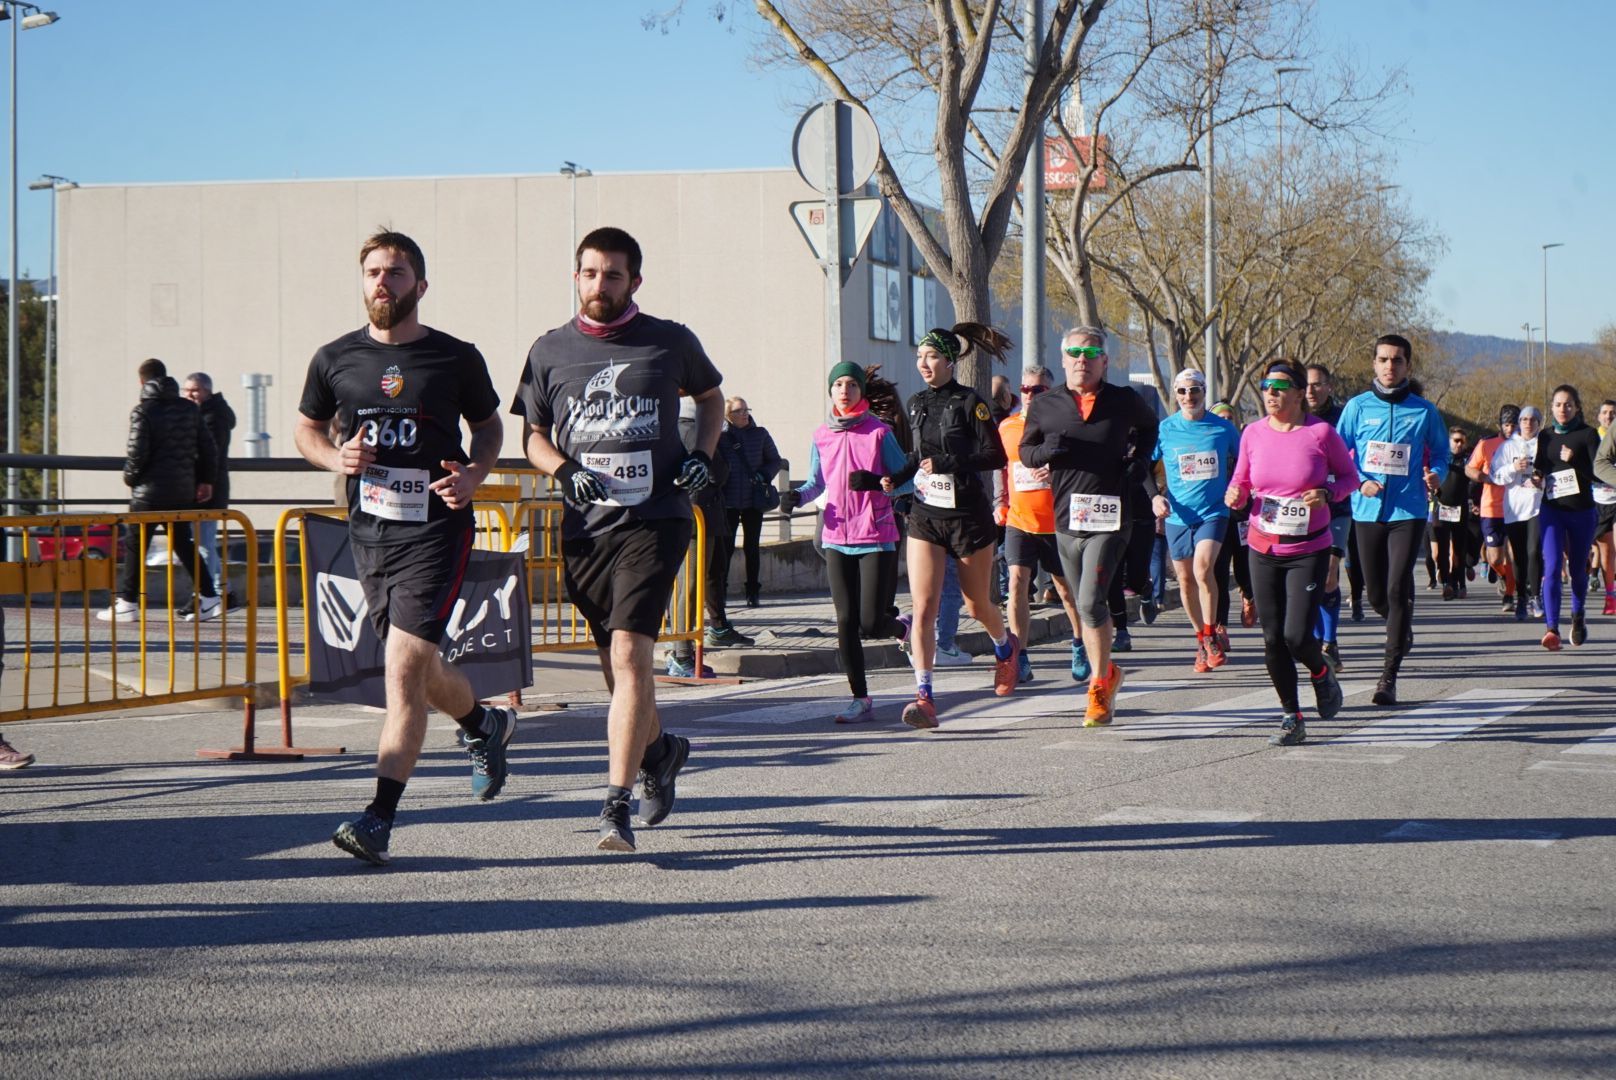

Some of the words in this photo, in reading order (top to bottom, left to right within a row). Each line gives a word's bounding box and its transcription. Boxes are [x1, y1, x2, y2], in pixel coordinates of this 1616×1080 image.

[361, 418, 417, 447] 360
[1390, 450, 1404, 459] 79
[1197, 457, 1216, 466] 140
[614, 464, 648, 479] 483
[390, 480, 424, 494] 495
[930, 480, 951, 491] 498
[1093, 503, 1117, 513] 392
[1281, 506, 1306, 517] 390
